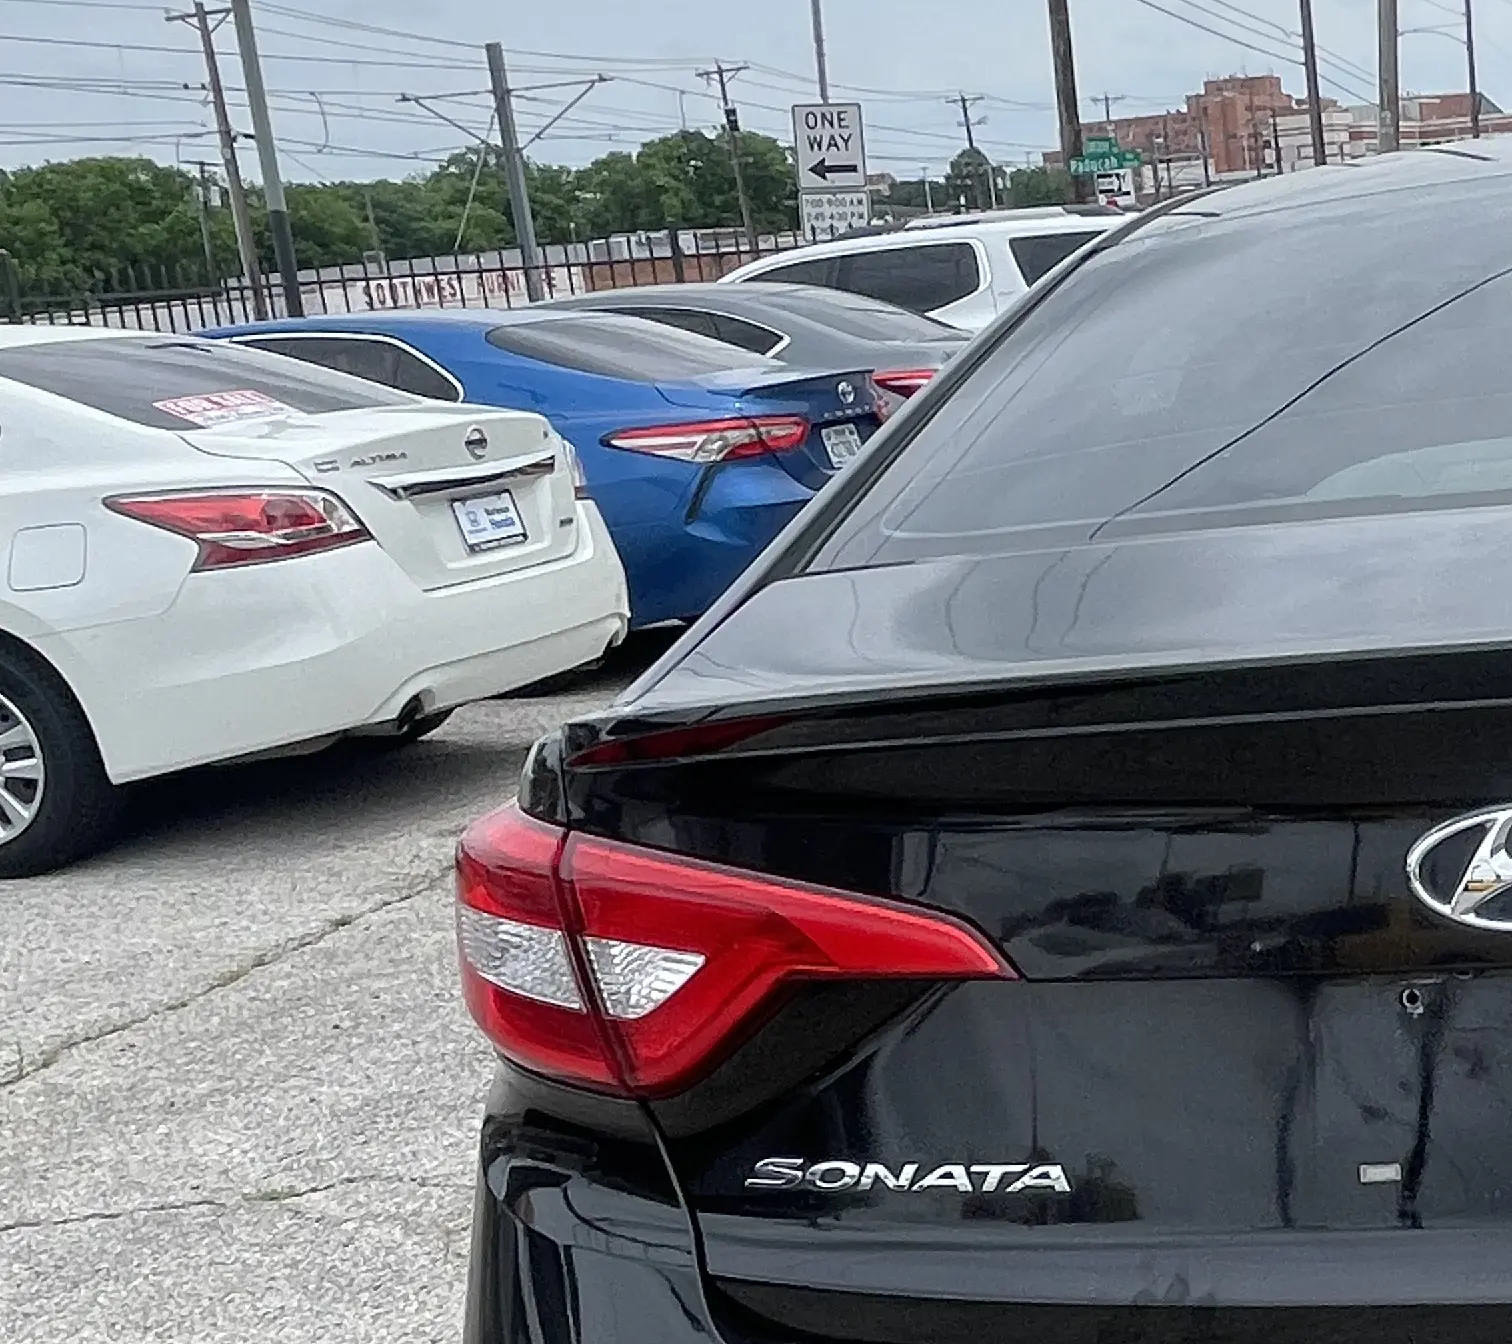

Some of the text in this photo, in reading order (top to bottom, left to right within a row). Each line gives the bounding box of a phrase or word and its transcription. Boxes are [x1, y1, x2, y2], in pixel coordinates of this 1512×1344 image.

[804, 110, 850, 130] ONE
[806, 133, 853, 152] WAY
[362, 277, 466, 308] SOUTHWES
[745, 1157, 1072, 1193] SONATA
